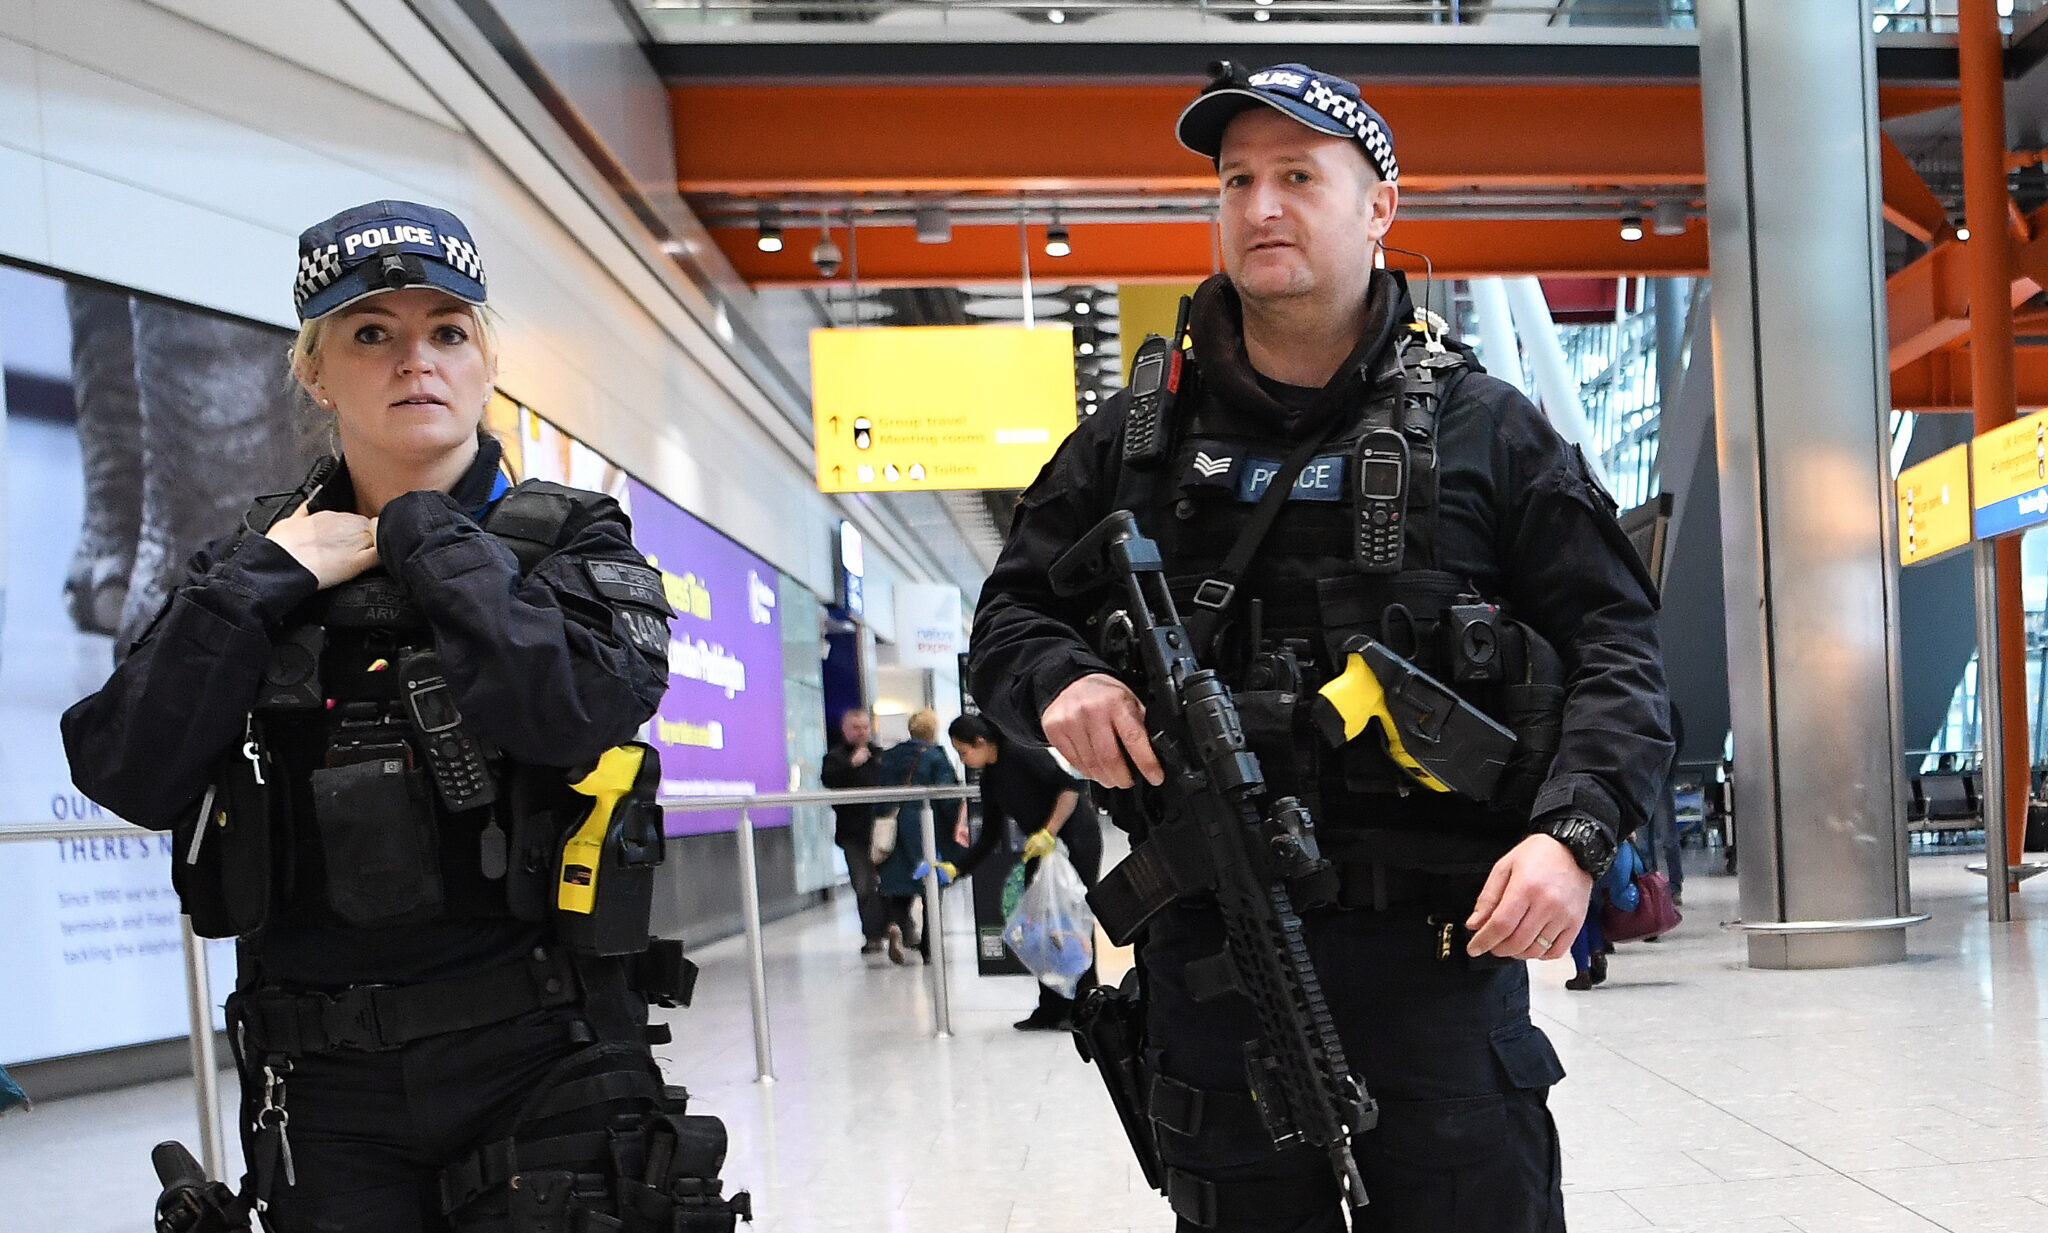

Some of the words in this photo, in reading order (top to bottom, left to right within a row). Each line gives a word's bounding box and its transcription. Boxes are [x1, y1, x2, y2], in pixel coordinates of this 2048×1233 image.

[345, 225, 435, 256] POLICE
[1250, 465, 1331, 492] PCE
[367, 607, 400, 620] ARV
